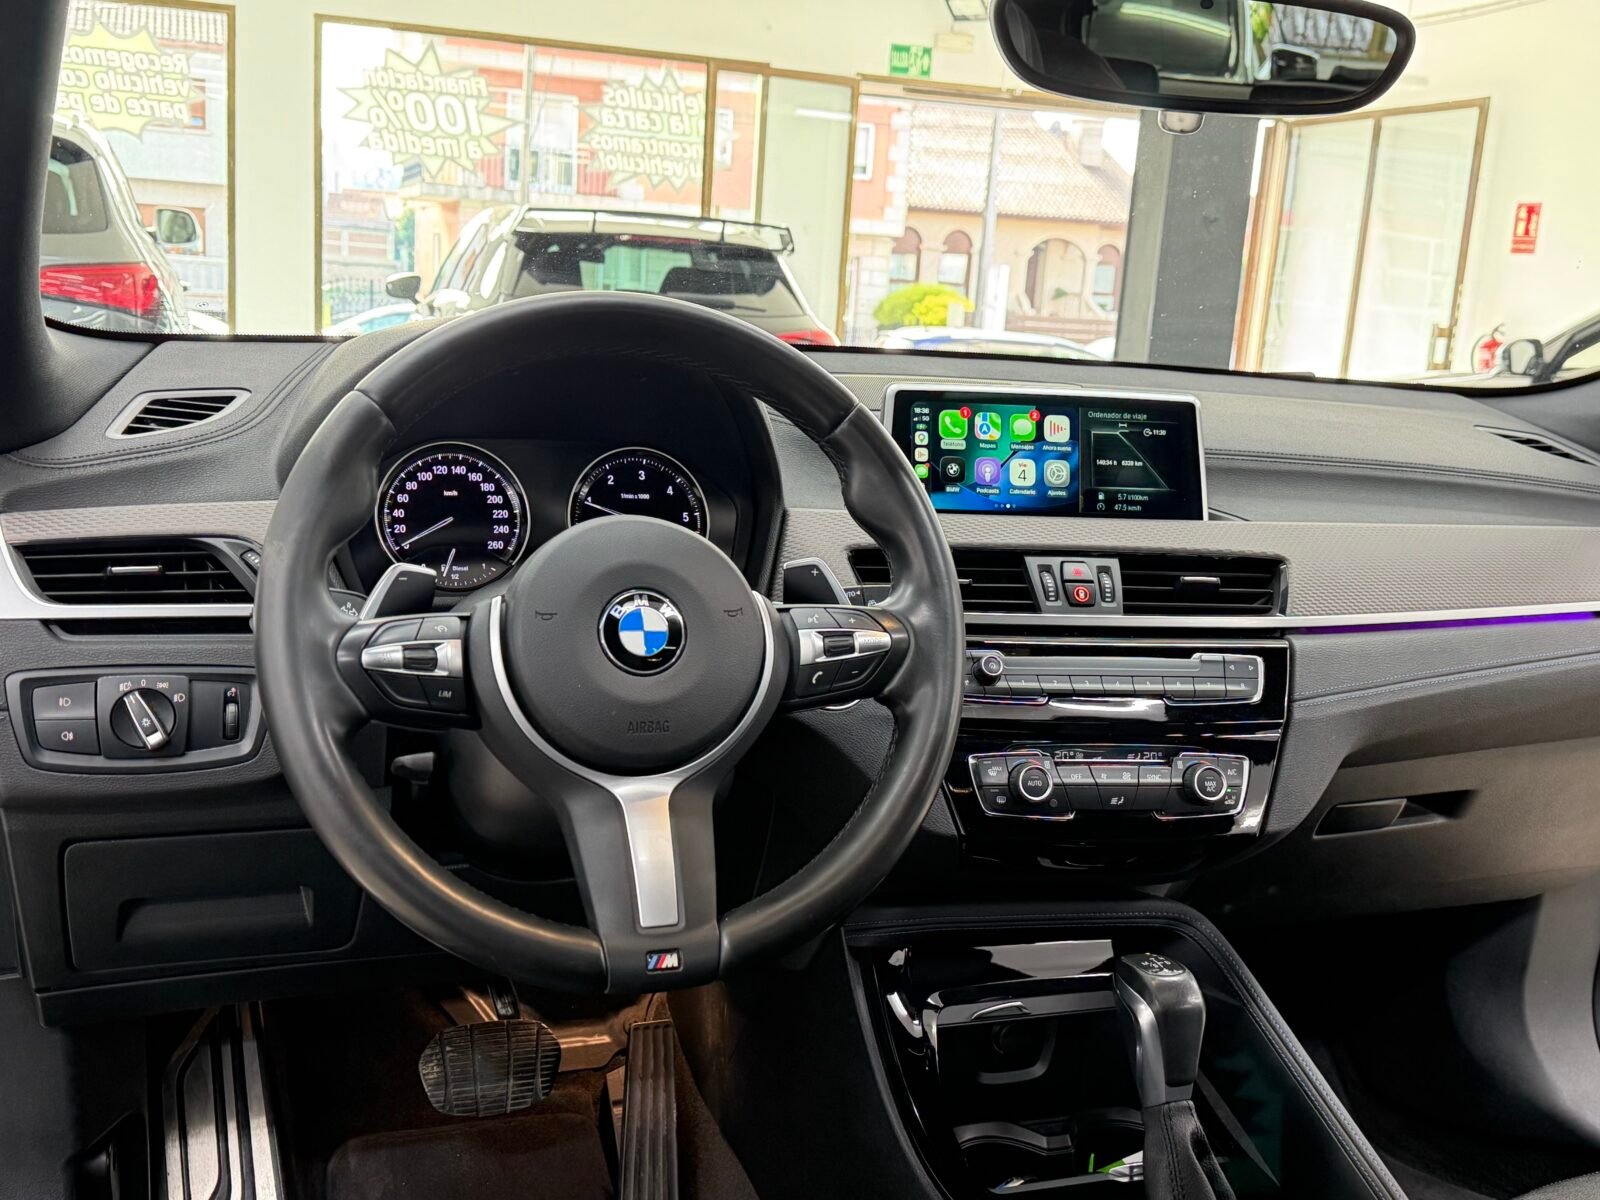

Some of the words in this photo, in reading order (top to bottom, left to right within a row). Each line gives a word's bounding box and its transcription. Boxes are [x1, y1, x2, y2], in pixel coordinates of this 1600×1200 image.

[1088, 411, 1120, 419] Ordenador
[1132, 412, 1147, 420] viaje
[432, 465, 448, 475] 120
[451, 465, 466, 475] 140
[1018, 469, 1026, 481] 4
[416, 471, 433, 481] 100
[467, 472, 483, 482] 160
[607, 474, 615, 485] 2
[638, 470, 646, 481] 3
[405, 481, 418, 490] 80
[480, 483, 495, 492] 180
[666, 485, 674, 495] 4
[397, 494, 409, 503] 60
[486, 495, 503, 504] 200
[392, 509, 405, 518] 40
[492, 510, 509, 519] 220
[682, 512, 689, 522] 5
[394, 524, 406, 534] 20
[493, 525, 509, 534] 240
[487, 540, 504, 550] 260
[438, 690, 452, 698] LIM
[627, 720, 670, 734] AIRBAG
